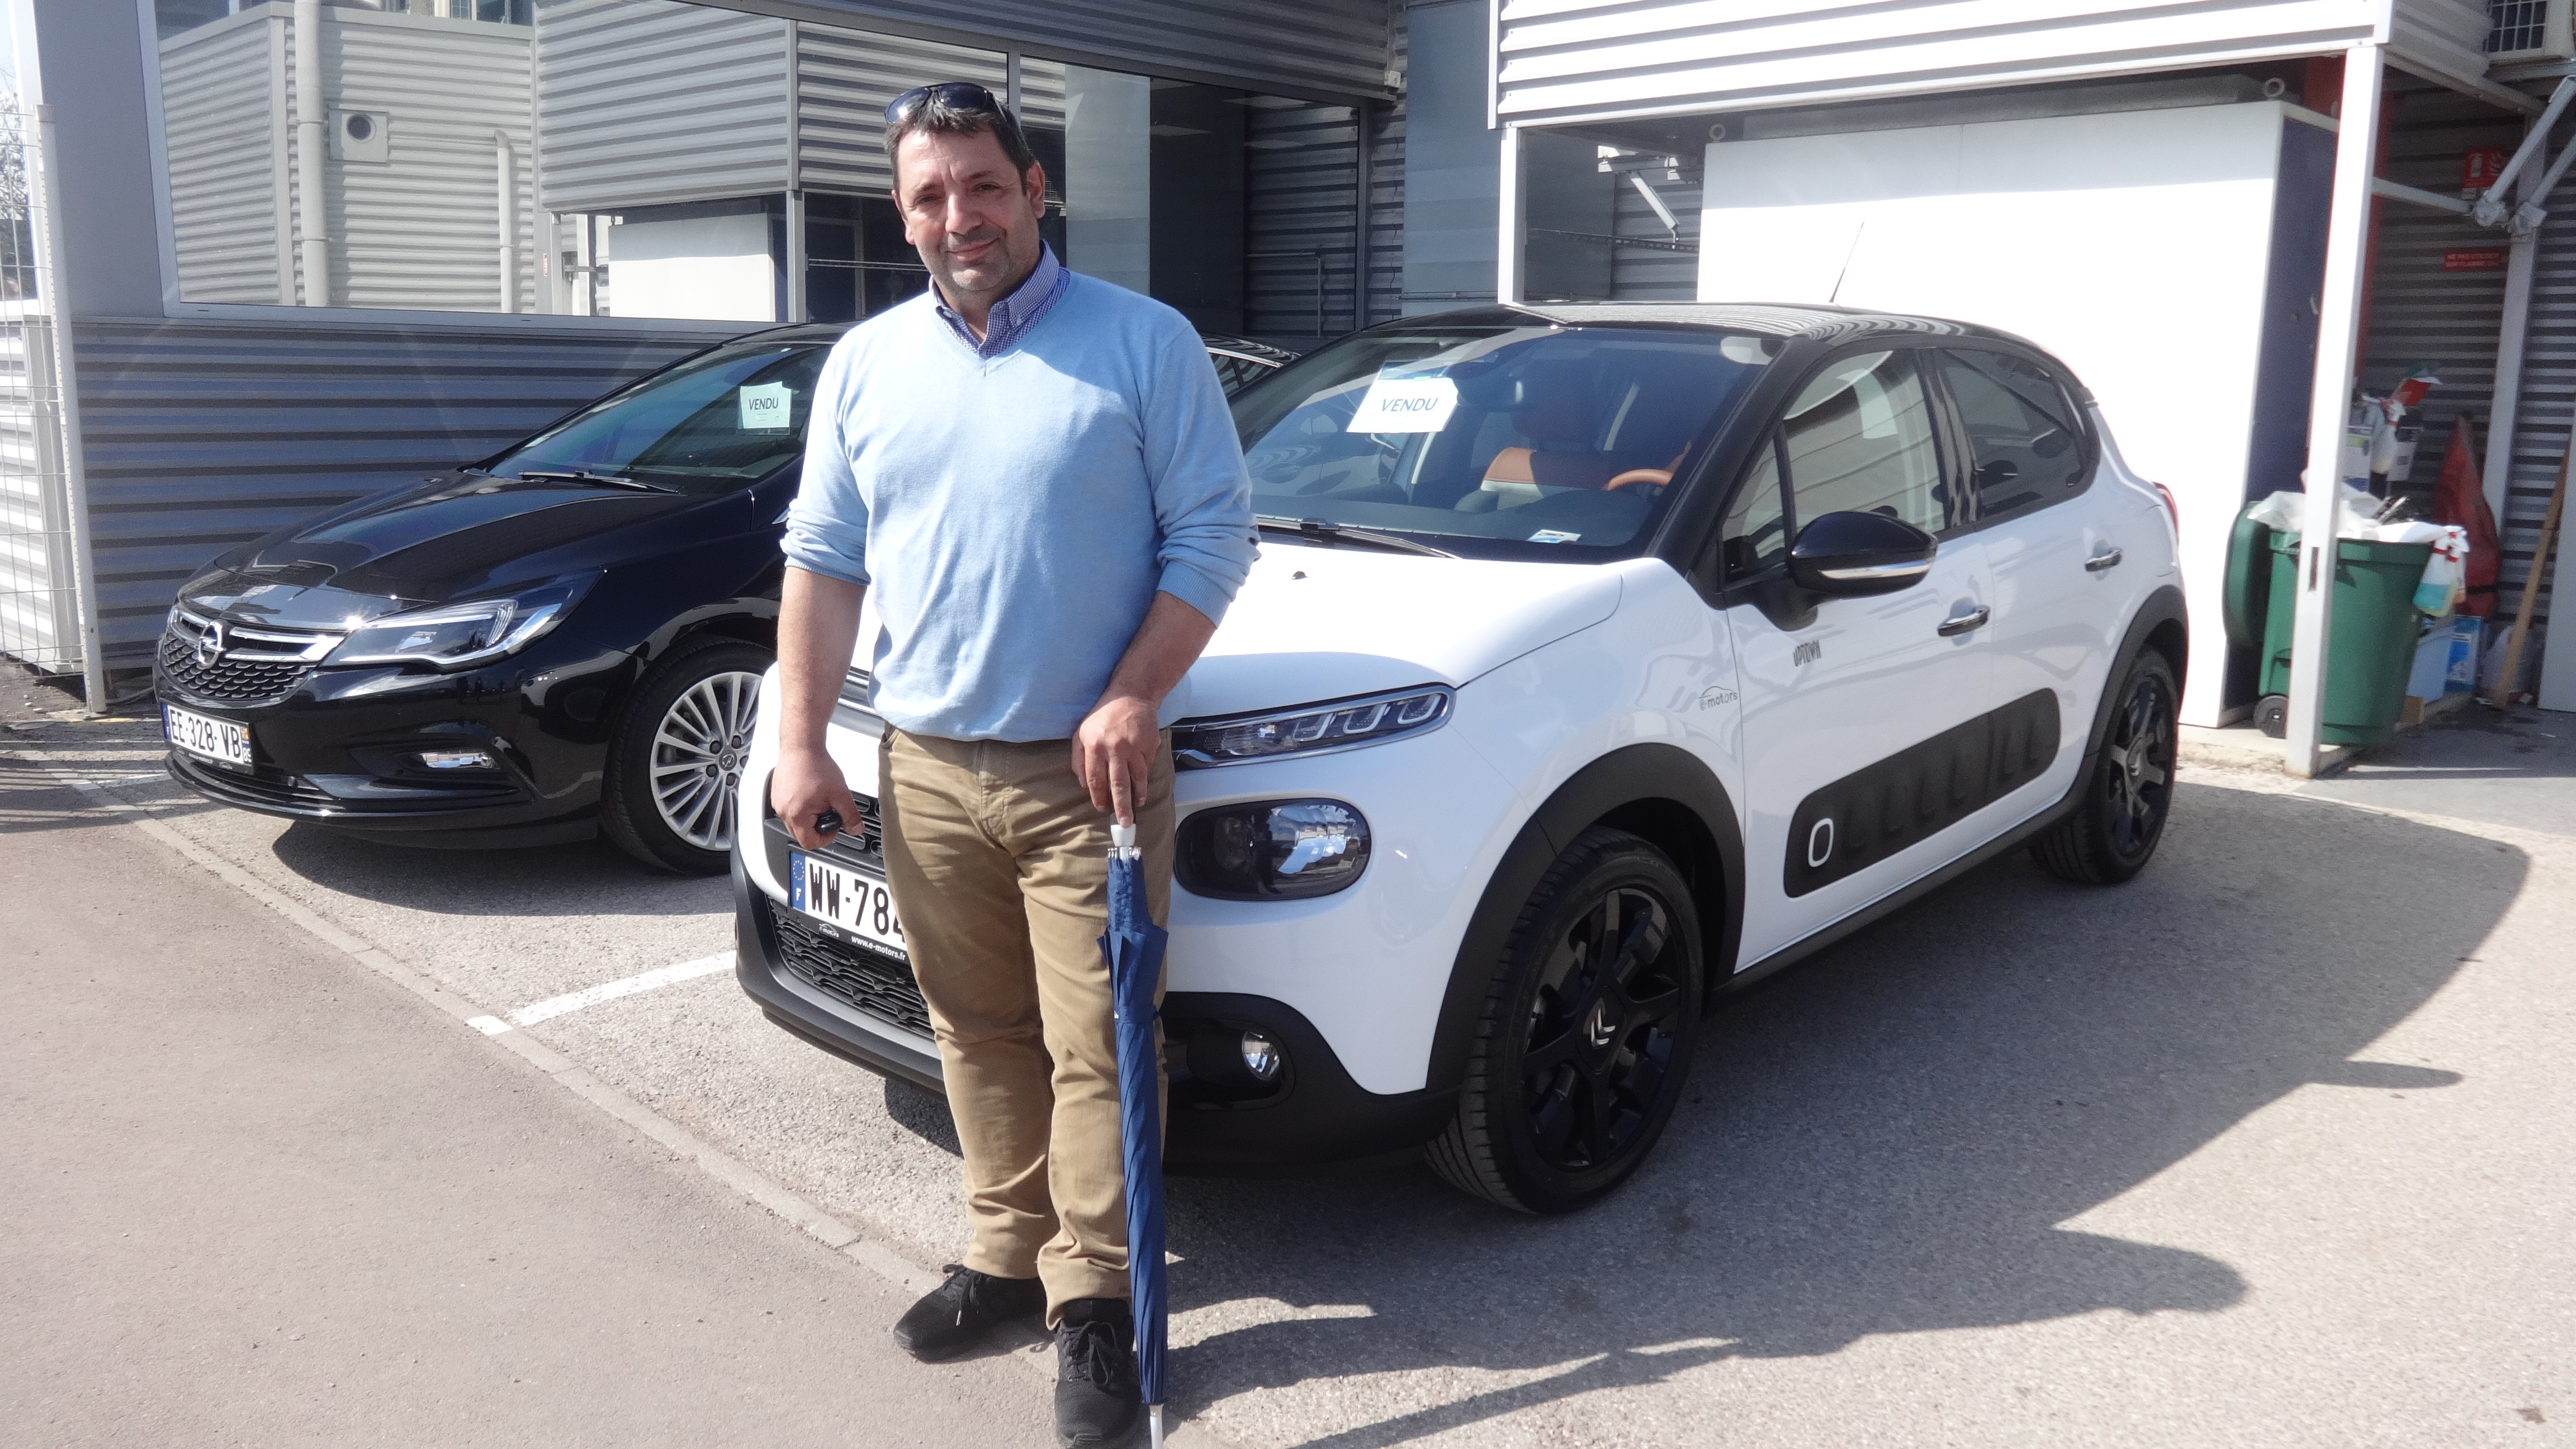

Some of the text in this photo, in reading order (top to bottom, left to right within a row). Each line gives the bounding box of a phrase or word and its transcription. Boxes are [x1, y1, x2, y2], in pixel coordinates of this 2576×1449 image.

[749, 397, 779, 410] VENDU
[1382, 397, 1439, 411] VENDU
[796, 888, 802, 901] F
[851, 935, 906, 961] www.e-motors.fr
